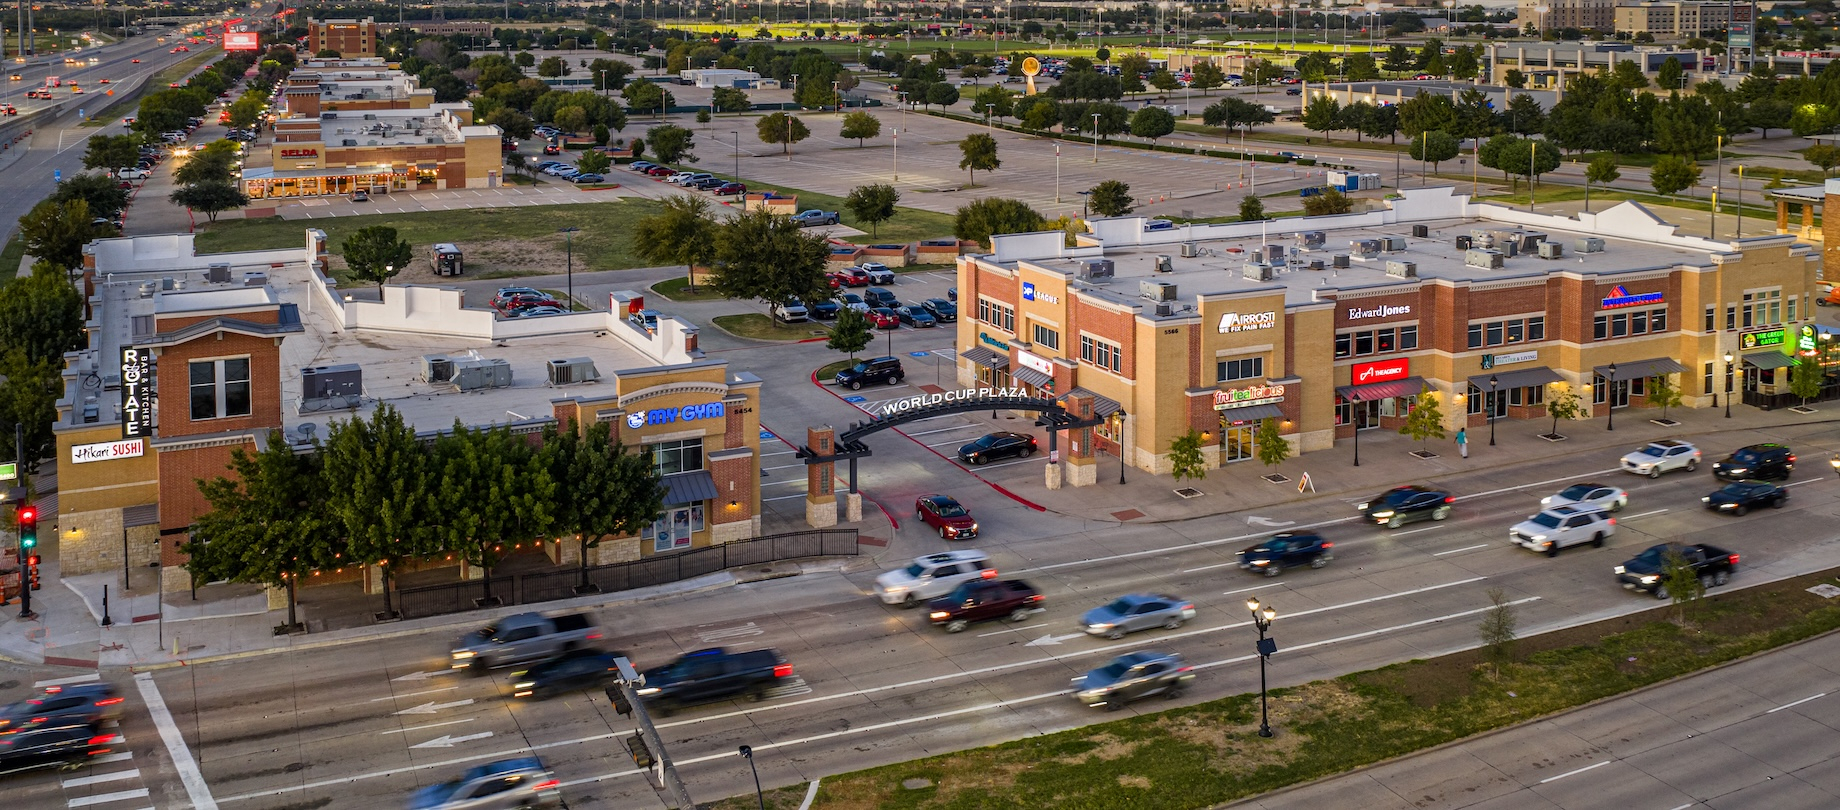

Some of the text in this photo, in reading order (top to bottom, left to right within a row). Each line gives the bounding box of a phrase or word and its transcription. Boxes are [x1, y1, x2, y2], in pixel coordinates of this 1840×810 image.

[281, 149, 318, 157] SELDA
[1034, 290, 1059, 305] LEAGUE
[1231, 311, 1276, 326] AIRROSTI
[1219, 326, 1230, 334] WE
[1259, 321, 1276, 329] FAST
[1767, 330, 1784, 338] GREEN
[1760, 337, 1780, 345] GATOR
[124, 350, 140, 435] ROTATE
[883, 387, 1028, 415] WORLD CUP PLAZA
[1214, 384, 1285, 404] fruitealicious
[142, 387, 150, 427] KITCHEN
[648, 402, 725, 426] MY GYM
[75, 441, 141, 460] Hikari SUSHI
